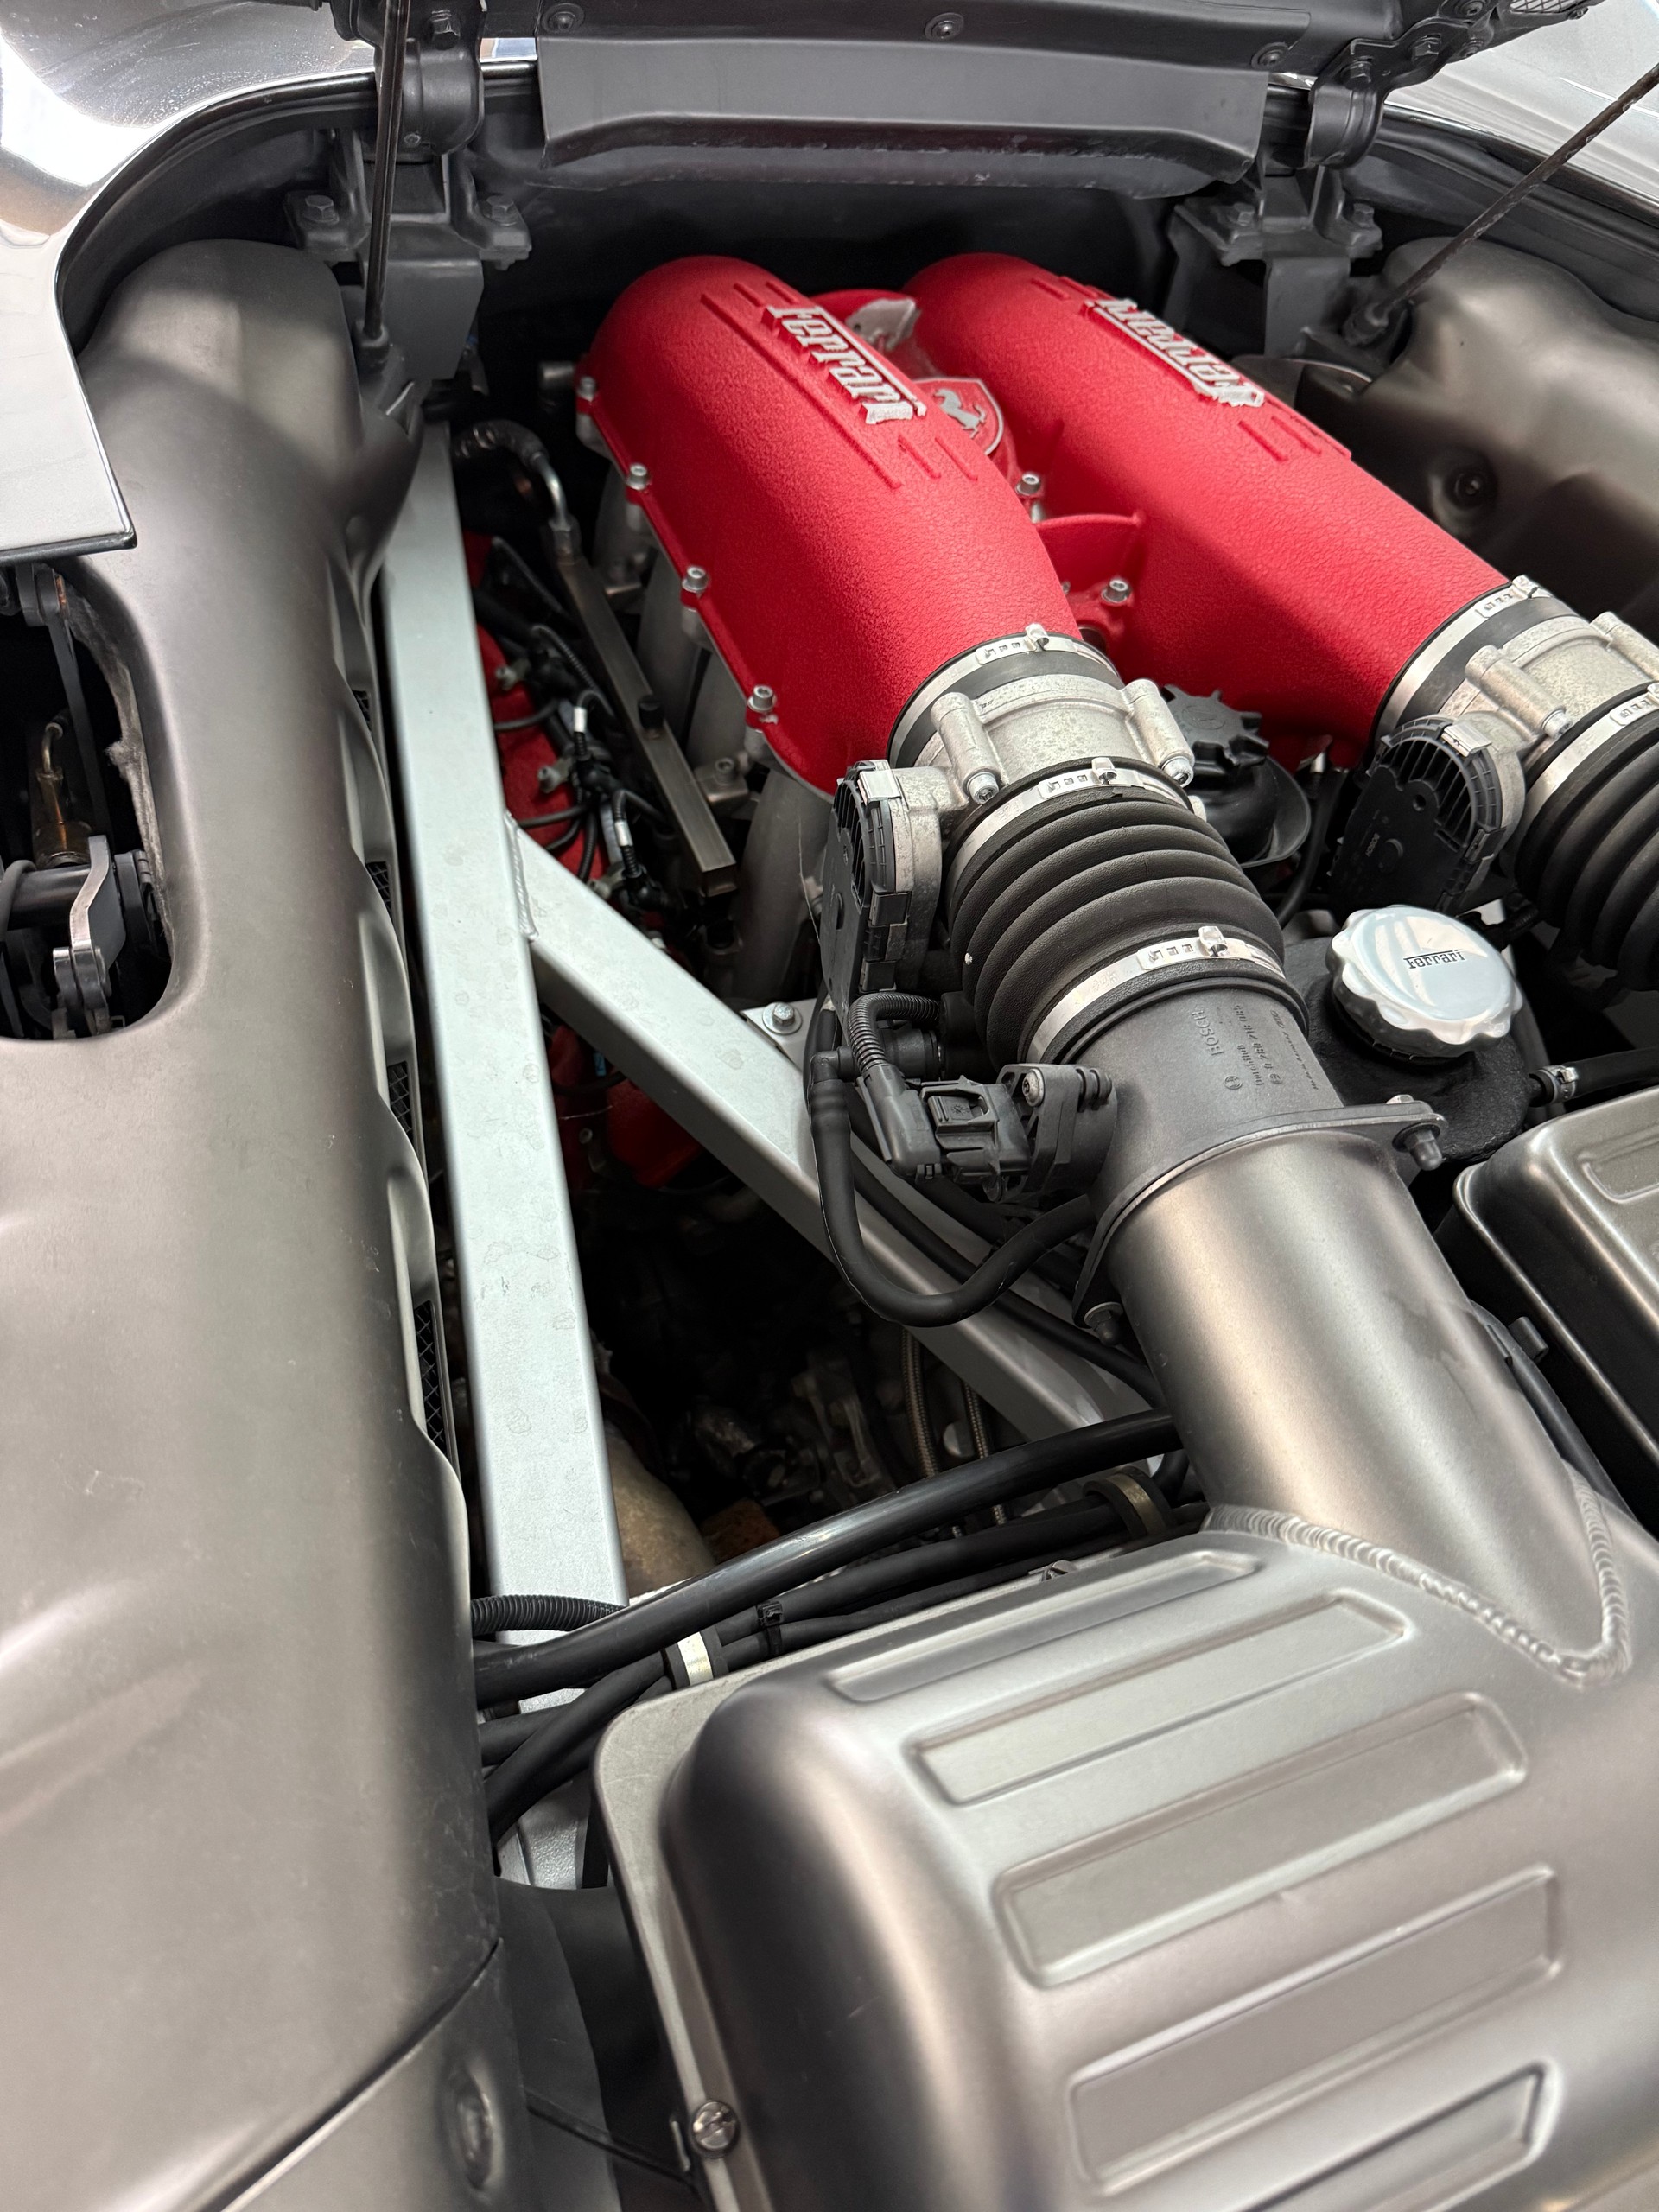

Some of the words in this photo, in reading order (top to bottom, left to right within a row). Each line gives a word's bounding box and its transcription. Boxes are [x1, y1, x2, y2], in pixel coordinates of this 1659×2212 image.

[766, 305, 927, 424] Ferrari
[1084, 298, 1265, 408] Ferrari
[1402, 949, 1465, 969] Ferrari
[1191, 1009, 1224, 1057] BOSCH
